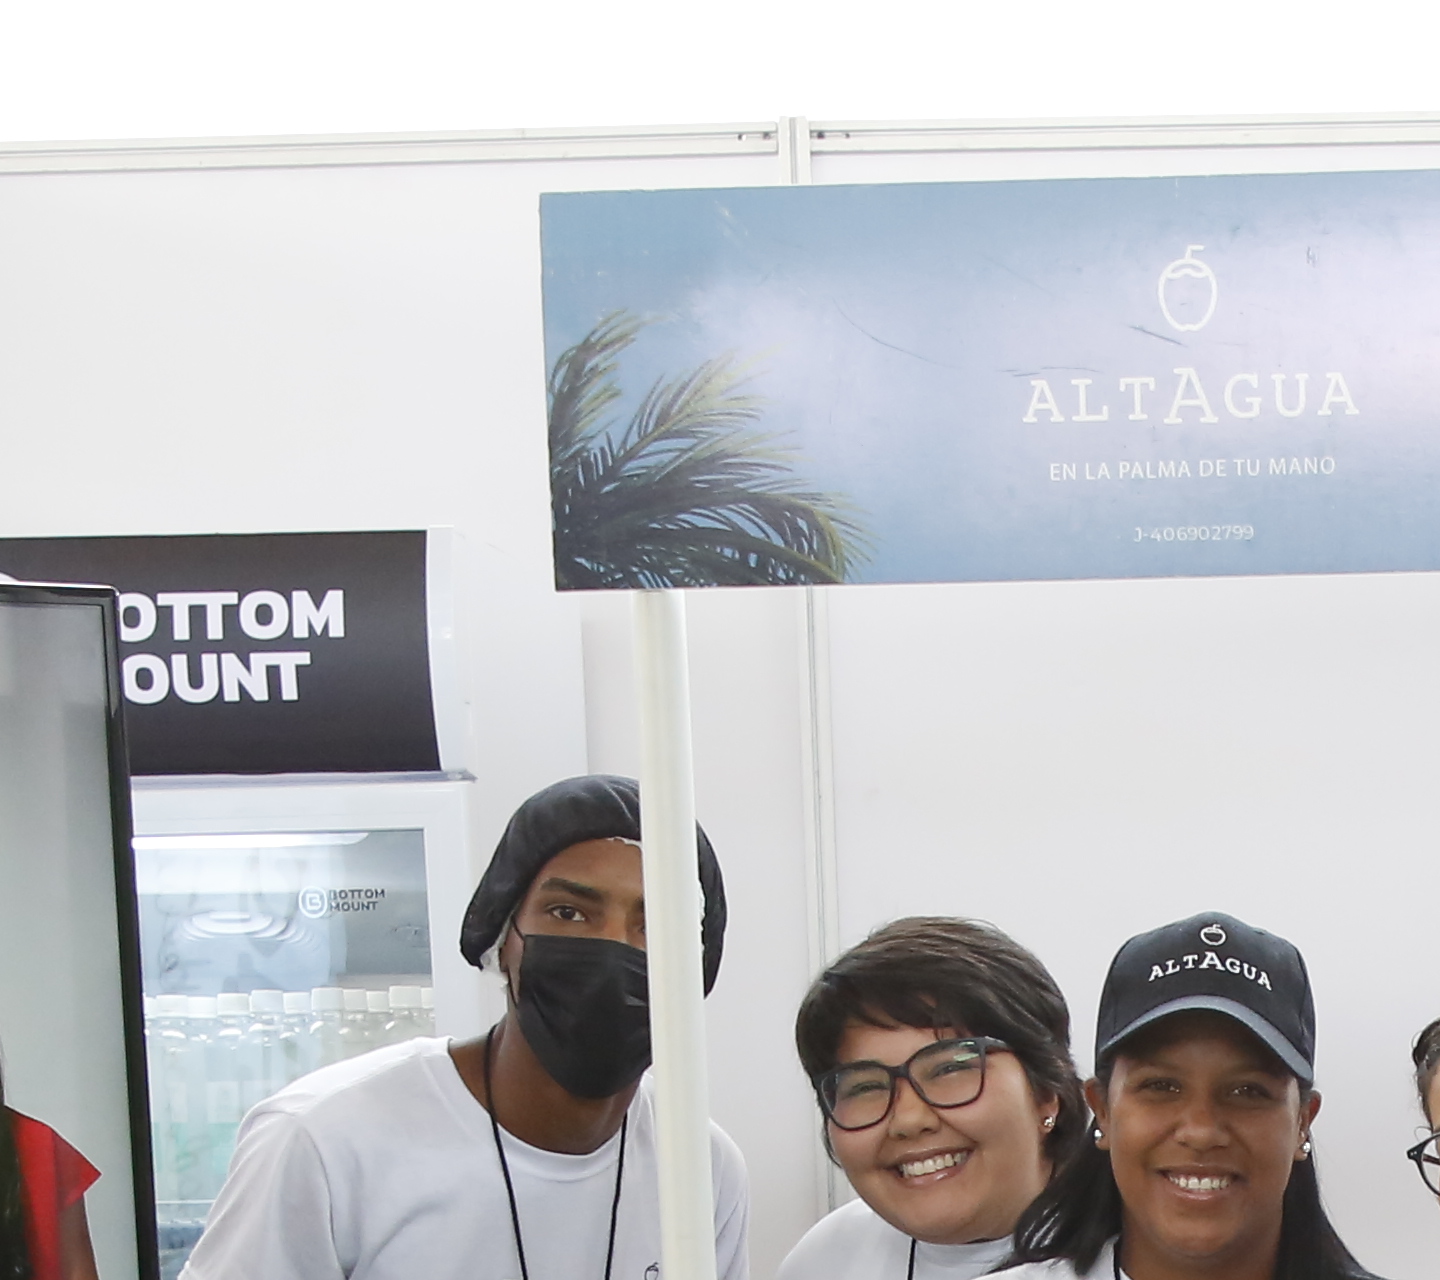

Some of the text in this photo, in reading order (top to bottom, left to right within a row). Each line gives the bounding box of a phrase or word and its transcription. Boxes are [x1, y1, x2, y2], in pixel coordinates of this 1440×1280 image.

[1022, 367, 1360, 425] ALTAGUA
[1050, 457, 1336, 481] EN LA PALMA DE TU MANO
[1133, 525, 1254, 542] J-406902799
[119, 589, 345, 642] OTTOM
[122, 651, 311, 704] OUNT
[329, 888, 386, 900] BOTTOM
[329, 901, 379, 912] MOUNT
[1148, 951, 1273, 991] ALTAGUA
